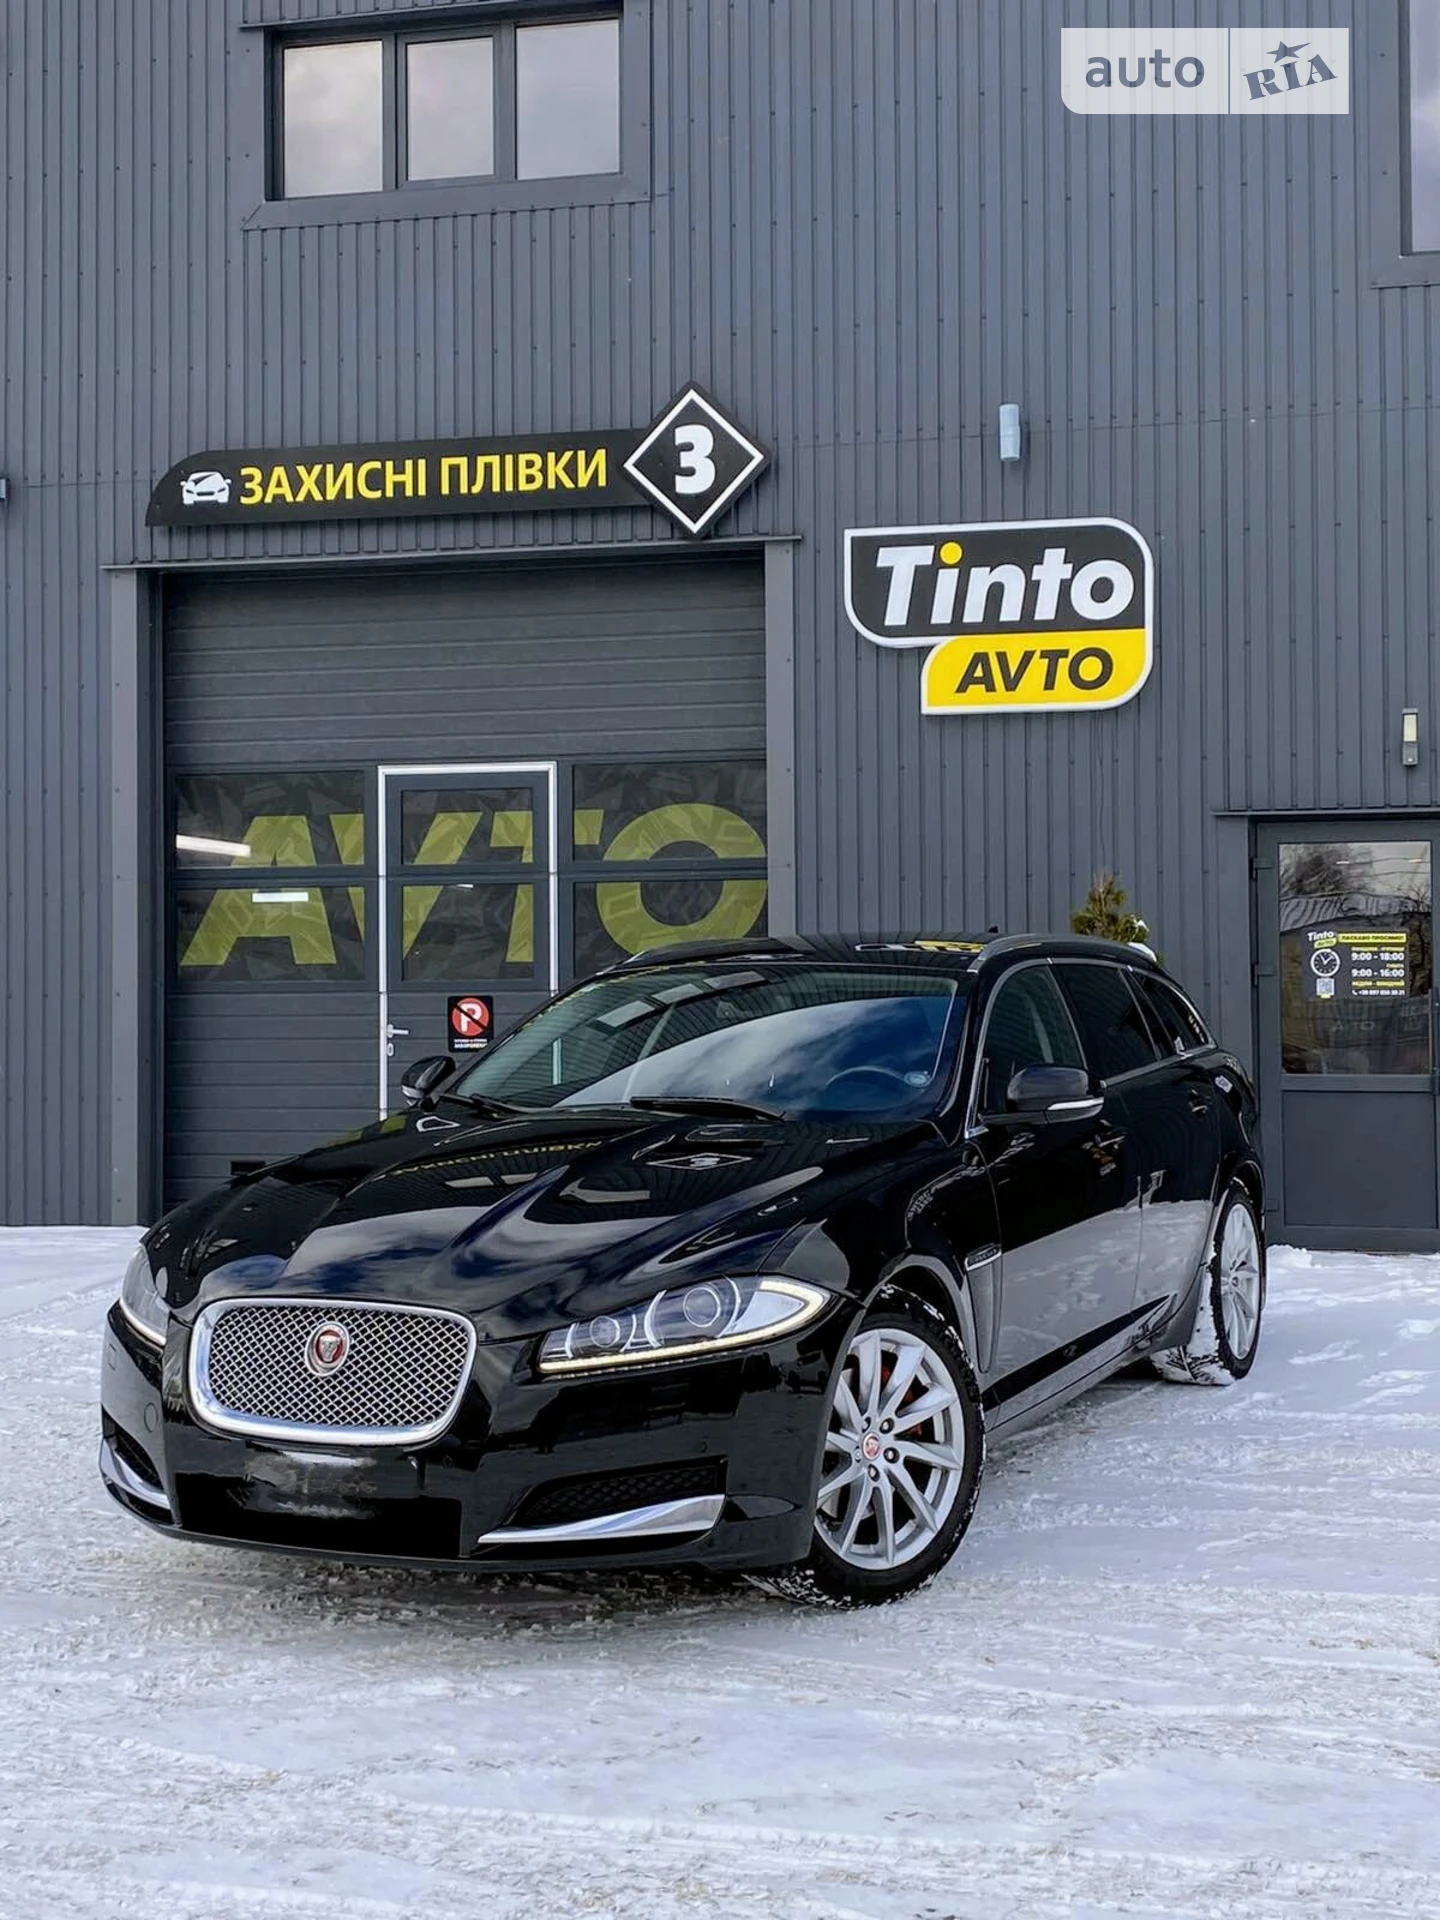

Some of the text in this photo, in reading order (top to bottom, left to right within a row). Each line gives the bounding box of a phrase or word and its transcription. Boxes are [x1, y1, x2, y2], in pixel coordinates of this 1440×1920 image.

[240, 448, 608, 506] ЗАХИСНІ ПЛІВКИ
[674, 424, 716, 495] 3
[876, 541, 1135, 626] Tinto
[955, 647, 1114, 694] AVTO
[1307, 931, 1335, 941] Tinto
[1351, 952, 1372, 961] 9:00
[1380, 952, 1405, 961] 18:00
[1351, 969, 1372, 977] 9:00
[1380, 969, 1405, 977] 16:00
[460, 1003, 482, 1032] P
